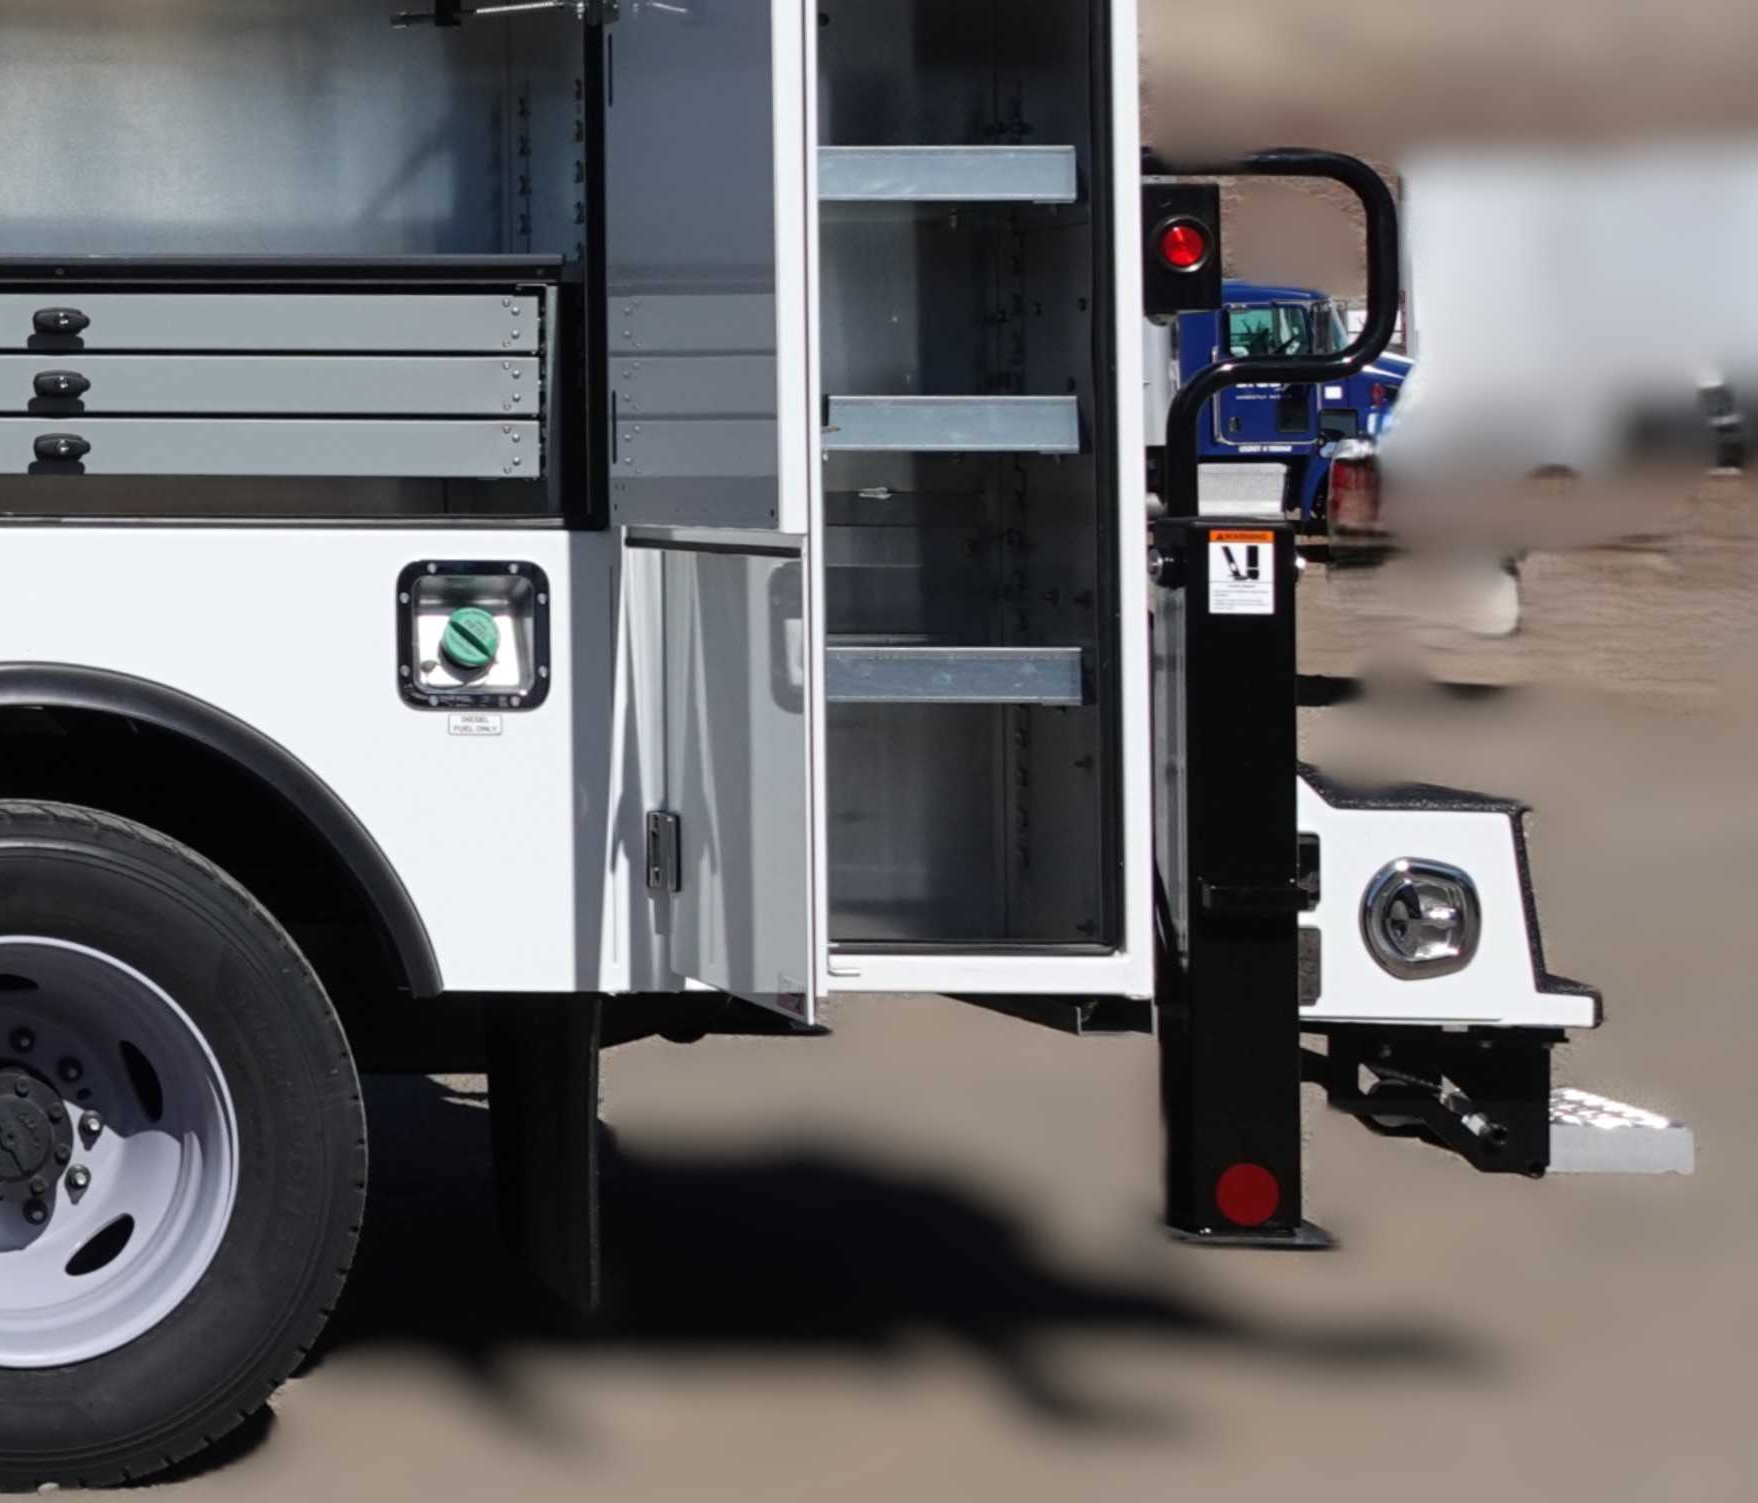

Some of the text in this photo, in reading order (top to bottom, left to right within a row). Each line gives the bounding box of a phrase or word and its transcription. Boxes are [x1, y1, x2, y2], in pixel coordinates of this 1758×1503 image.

[461, 716, 490, 724] DIESEL
[453, 725, 498, 733] FUEL ONLY
